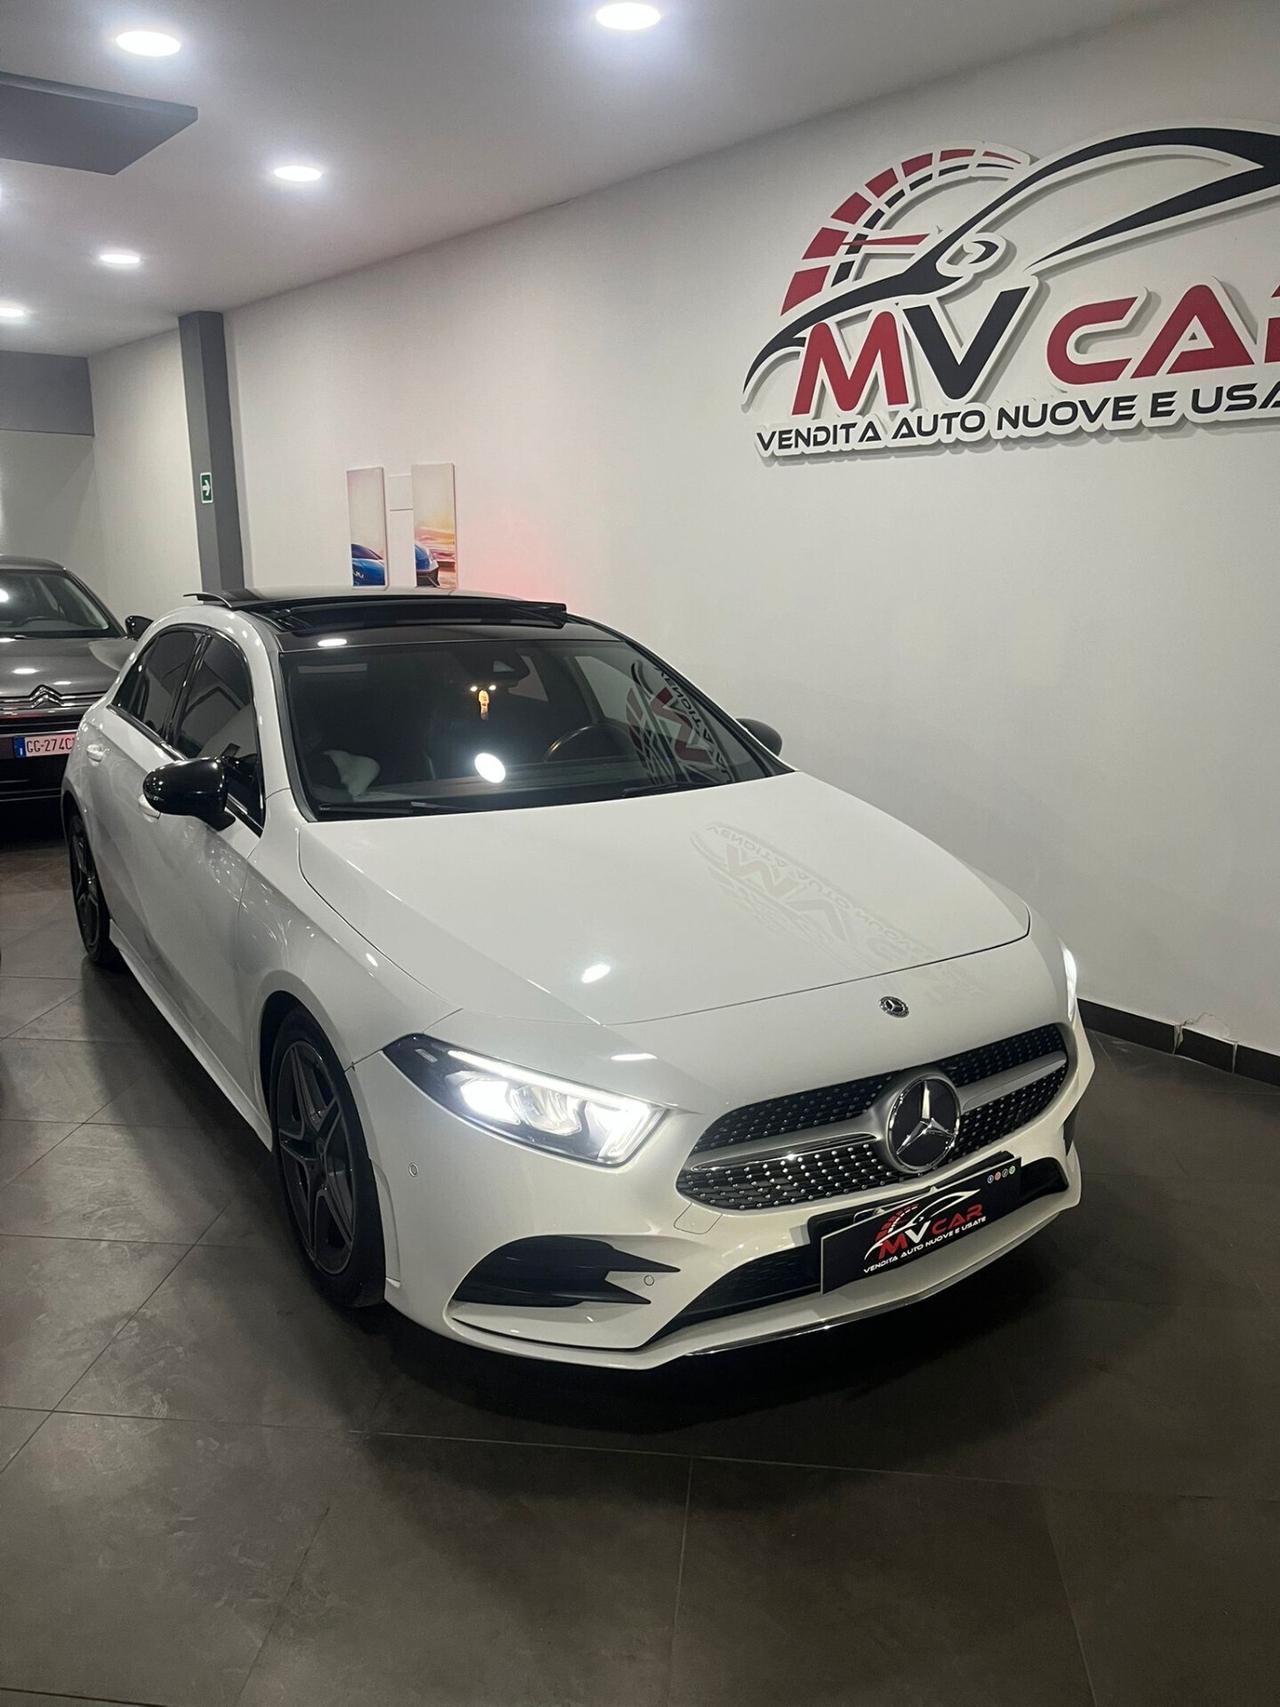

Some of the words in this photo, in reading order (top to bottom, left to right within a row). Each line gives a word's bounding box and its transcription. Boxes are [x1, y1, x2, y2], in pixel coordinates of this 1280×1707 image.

[791, 286, 1031, 416] MV
[1046, 284, 1280, 385] CA
[756, 423, 885, 452] VENDITA
[891, 409, 986, 440] AUTO
[996, 394, 1137, 431] NUOVE
[1149, 390, 1179, 419] E
[863, 1254, 898, 1274] VENDITA
[900, 1244, 924, 1259] AUTO
[925, 1231, 954, 1247] NUOVE
[954, 1226, 960, 1234] E
[960, 1215, 987, 1231] USATE
[878, 1220, 931, 1260] MV
[931, 1203, 984, 1235] CAR
